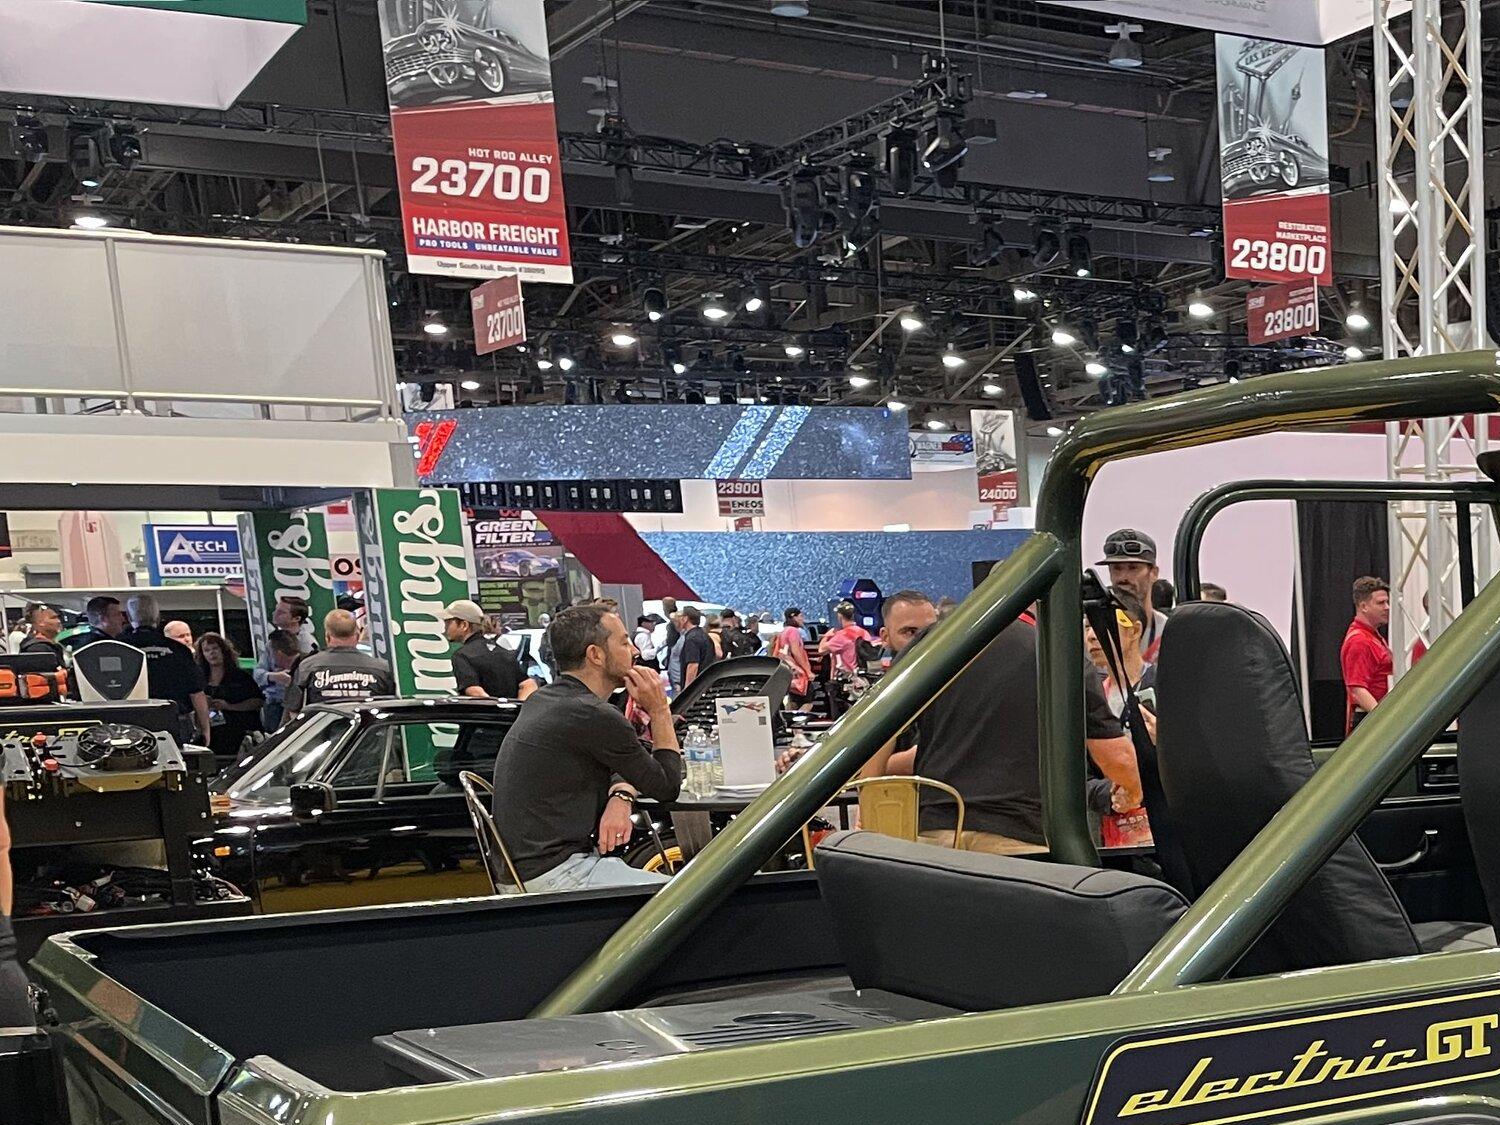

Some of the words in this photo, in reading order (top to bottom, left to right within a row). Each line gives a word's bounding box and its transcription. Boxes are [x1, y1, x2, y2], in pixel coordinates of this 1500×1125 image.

[468, 147, 490, 158] HOT
[493, 150, 516, 161] ROD
[519, 153, 553, 165] ALLEY
[410, 156, 551, 204] 23700
[412, 216, 486, 240] HARBOR
[488, 222, 560, 245] FREIGHT
[418, 238, 438, 248] PRO
[439, 239, 469, 250] TOOLS
[474, 243, 530, 254] UNBEATABLE
[531, 246, 559, 257] VALUE
[1231, 238, 1326, 275] 23800
[486, 305, 522, 344] 23700
[1264, 302, 1316, 337] 23800
[718, 482, 761, 494] 23900
[980, 488, 1018, 501] 24000
[731, 500, 764, 509] ENEOS
[474, 520, 538, 533] GREEN
[475, 531, 536, 544] FILTER
